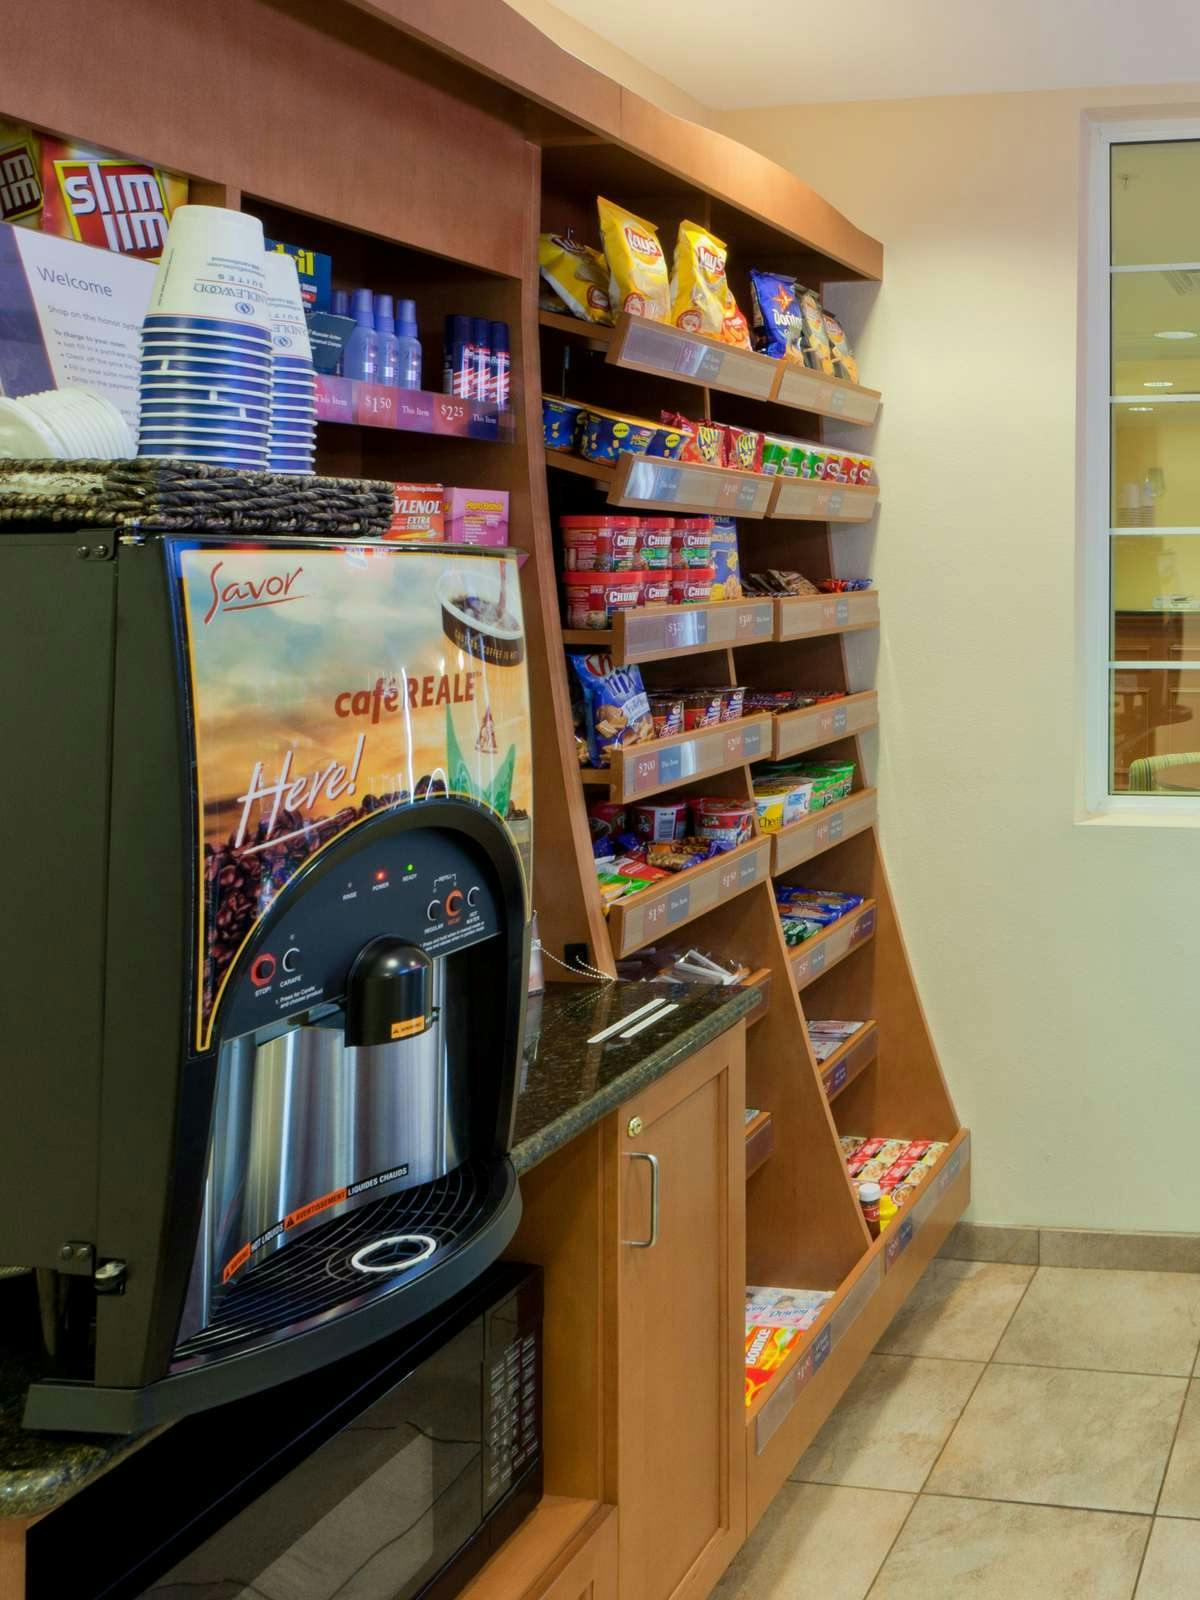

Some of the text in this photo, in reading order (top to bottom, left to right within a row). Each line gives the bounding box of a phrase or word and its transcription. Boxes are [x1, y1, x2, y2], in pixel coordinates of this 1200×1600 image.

[627, 228, 659, 255] Lay's
[36, 265, 113, 297] Welcome
[364, 395, 392, 413] $150
[440, 404, 464, 421] $225
[394, 499, 441, 514] YLENOL
[204, 561, 303, 624] Savor
[234, 733, 366, 849] Here!
[372, 881, 390, 892] POWER
[347, 1166, 407, 1197] LIQUIDES CHAUDS
